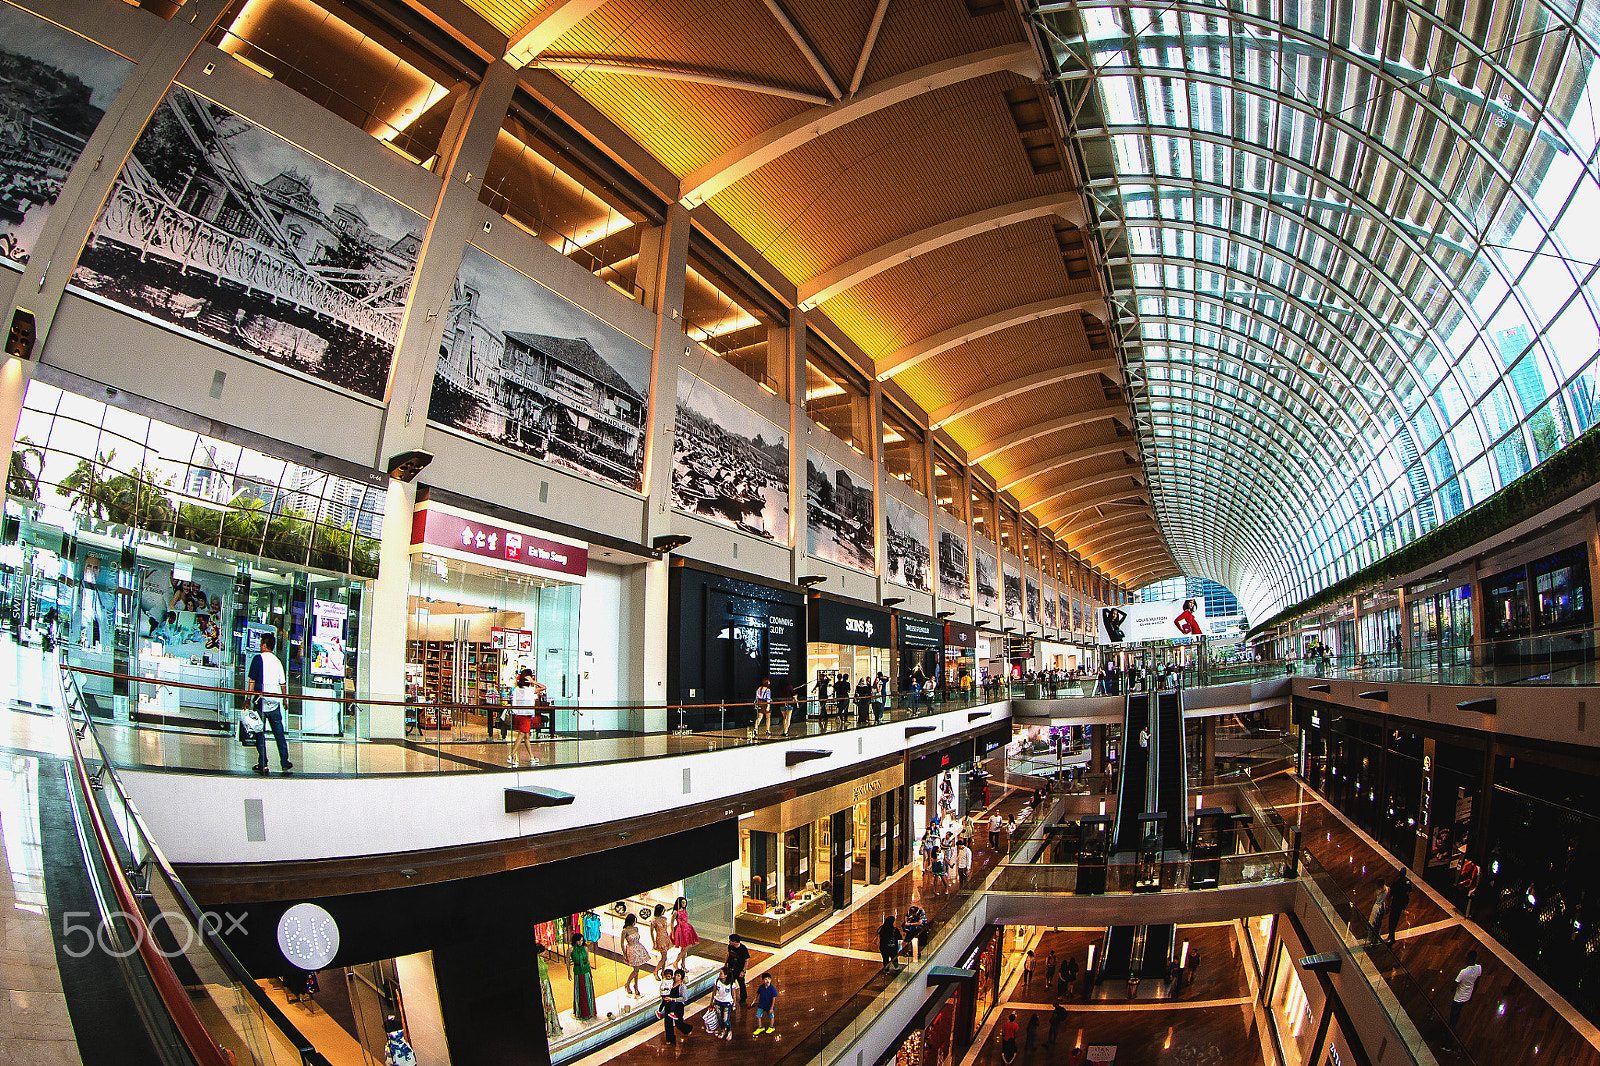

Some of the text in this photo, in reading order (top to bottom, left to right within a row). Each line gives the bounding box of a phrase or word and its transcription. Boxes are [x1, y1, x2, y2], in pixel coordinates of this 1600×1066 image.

[571, 402, 589, 413] SHIP
[593, 412, 636, 435] CHANDLERS
[528, 545, 568, 566] Eu Yan Sang
[769, 626, 785, 635] GLORY
